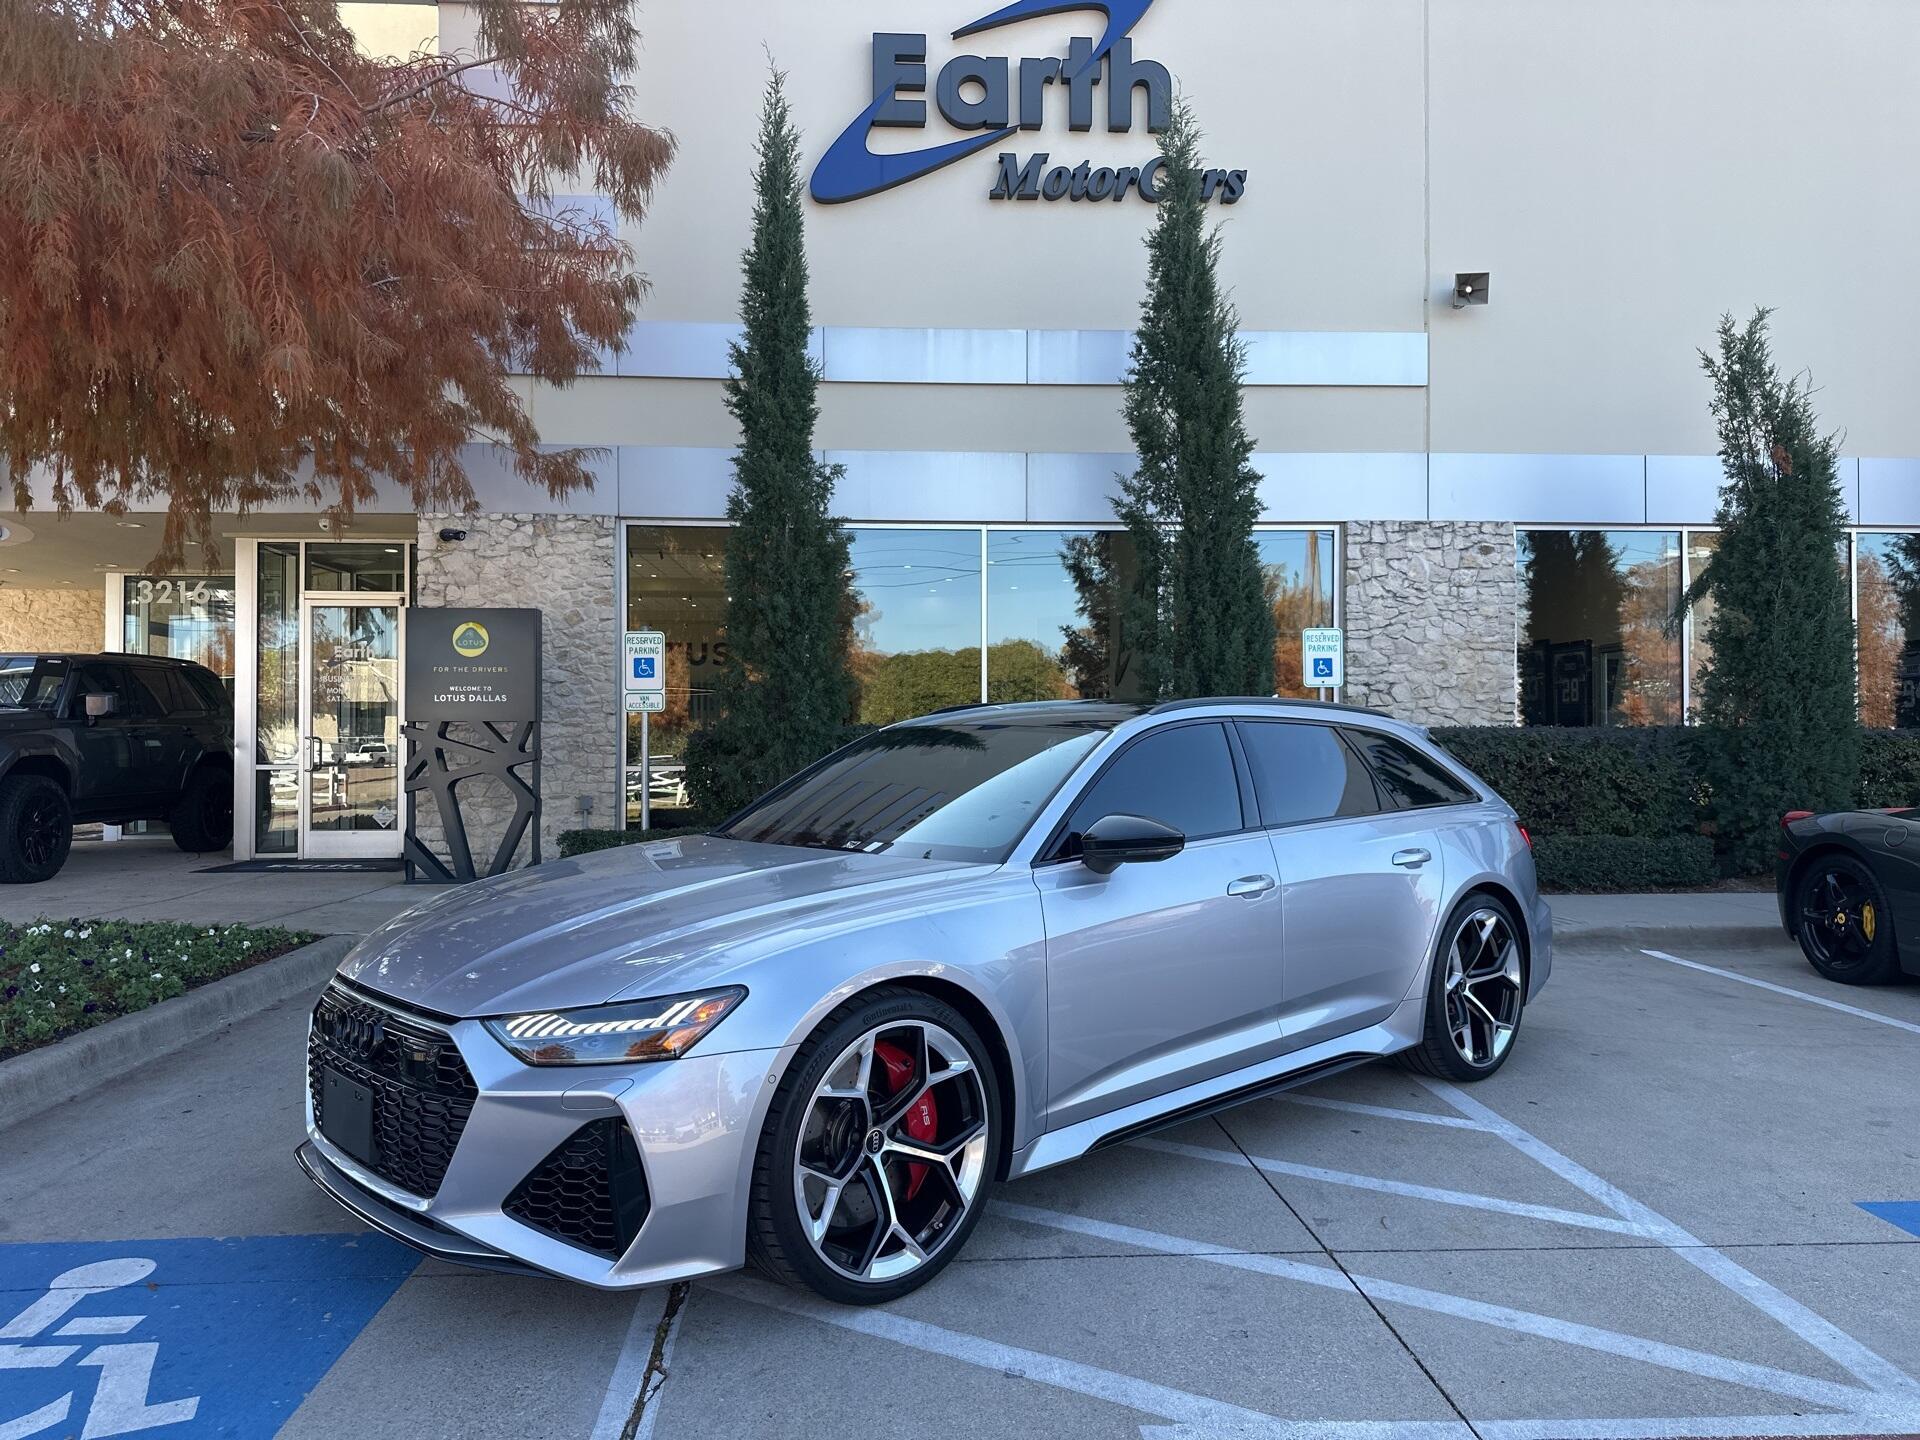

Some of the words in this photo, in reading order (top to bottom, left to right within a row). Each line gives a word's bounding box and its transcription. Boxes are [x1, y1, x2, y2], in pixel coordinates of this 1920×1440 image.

[872, 32, 1172, 133] Earth
[989, 152, 1248, 205] MotorCrs
[137, 580, 211, 604] 3216
[334, 645, 375, 658] Earth
[434, 694, 466, 702] LOTUS
[468, 694, 507, 702] DALLAS
[920, 1105, 931, 1126] RS
